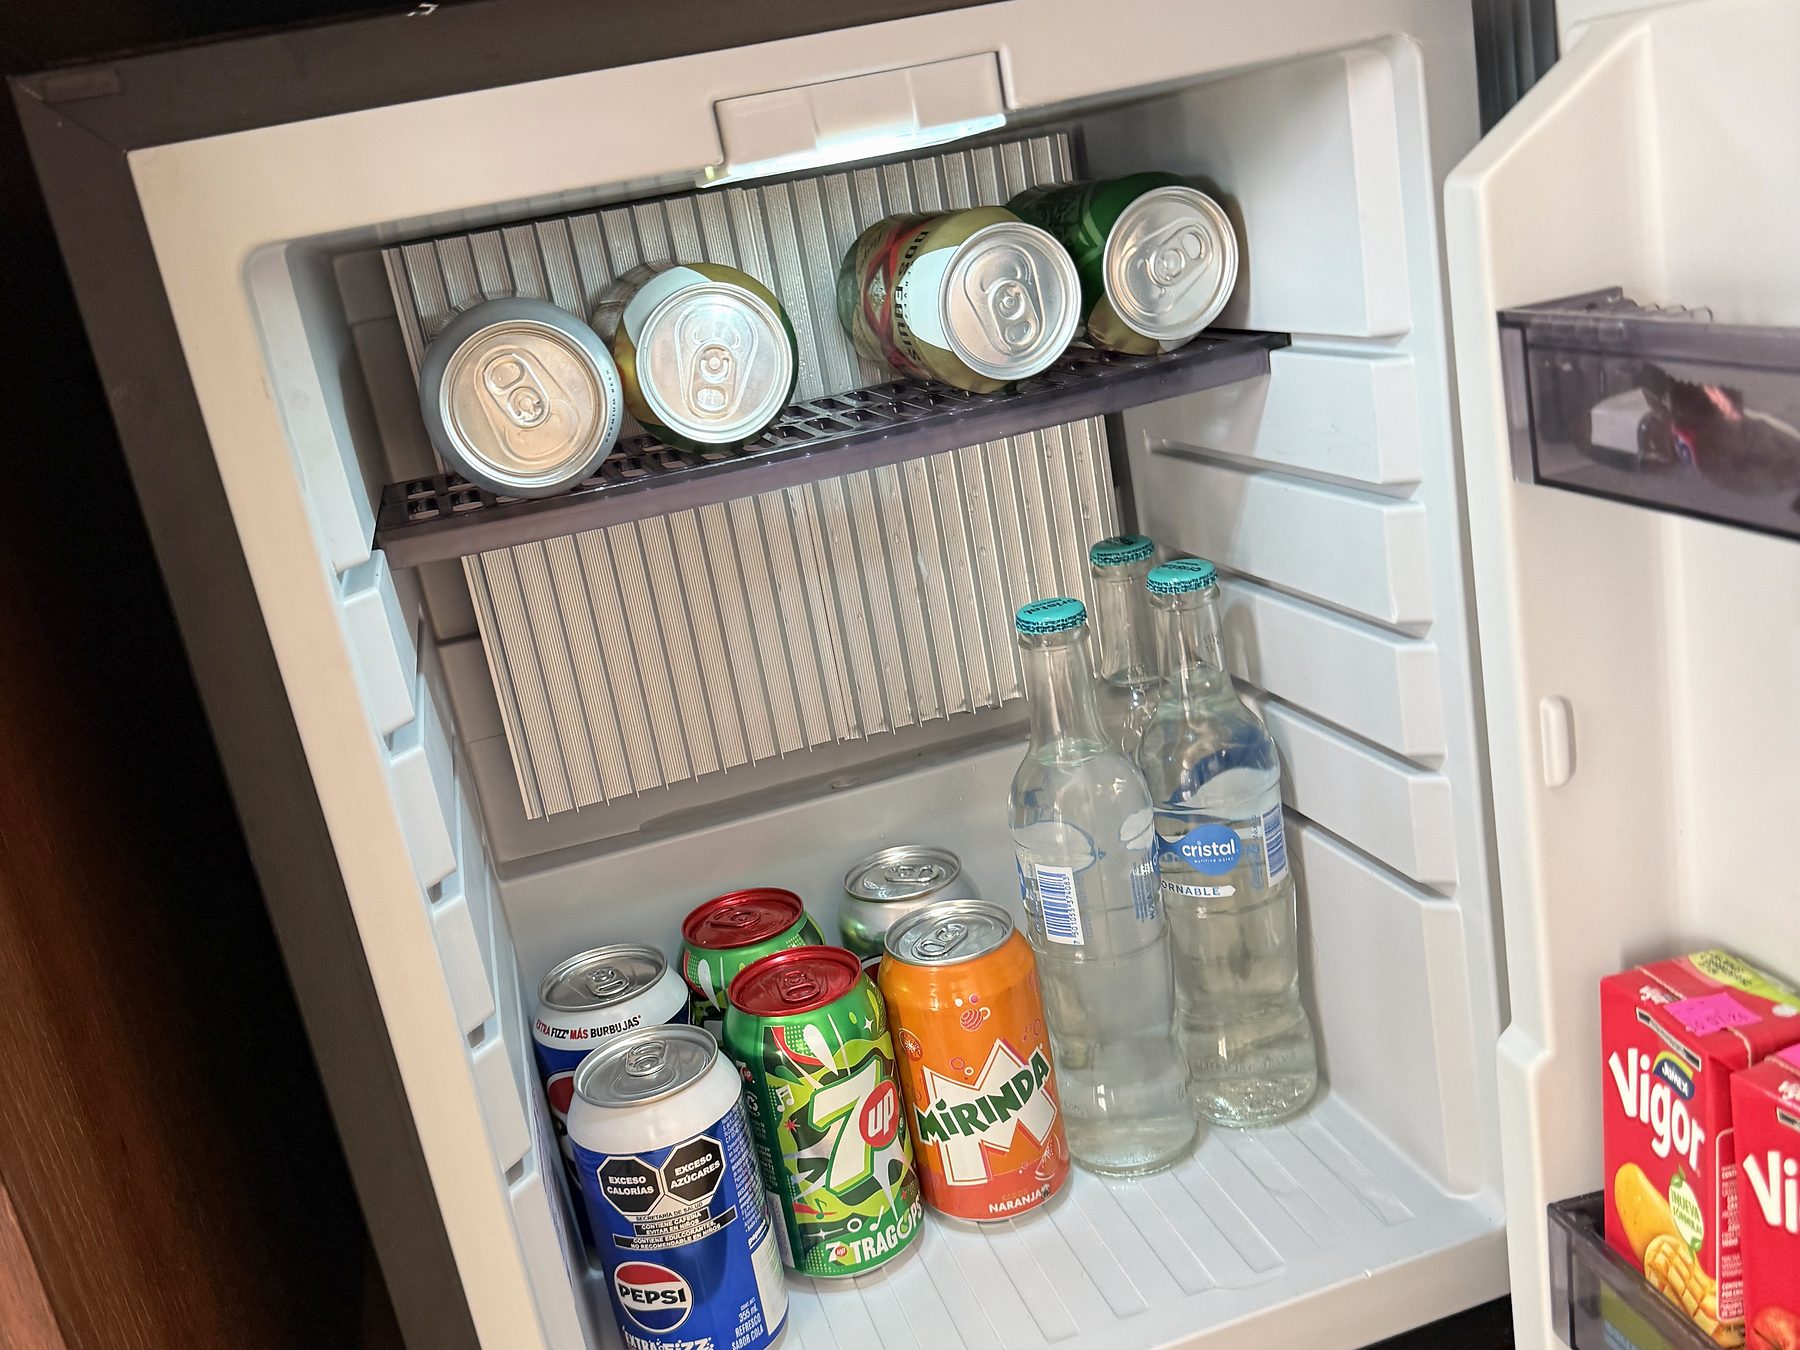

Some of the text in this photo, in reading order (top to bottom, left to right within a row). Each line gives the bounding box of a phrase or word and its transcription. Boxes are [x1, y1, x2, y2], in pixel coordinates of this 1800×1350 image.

[1182, 839, 1236, 858] cristal
[570, 1027, 588, 1040] MÁS
[1608, 1047, 1705, 1169] Vigor
[670, 1160, 721, 1190] AZÚCARES
[674, 1153, 713, 1177] EXCESO
[606, 1186, 655, 1196] CALORÍAS
[608, 1176, 647, 1186] EXCESO
[988, 1189, 1042, 1213] NARANJA
[618, 1283, 687, 1304] PEPSI
[735, 1312, 762, 1338] REFRESCO
[738, 1308, 751, 1323] 355
[731, 1323, 763, 1350] SABOR COLA
